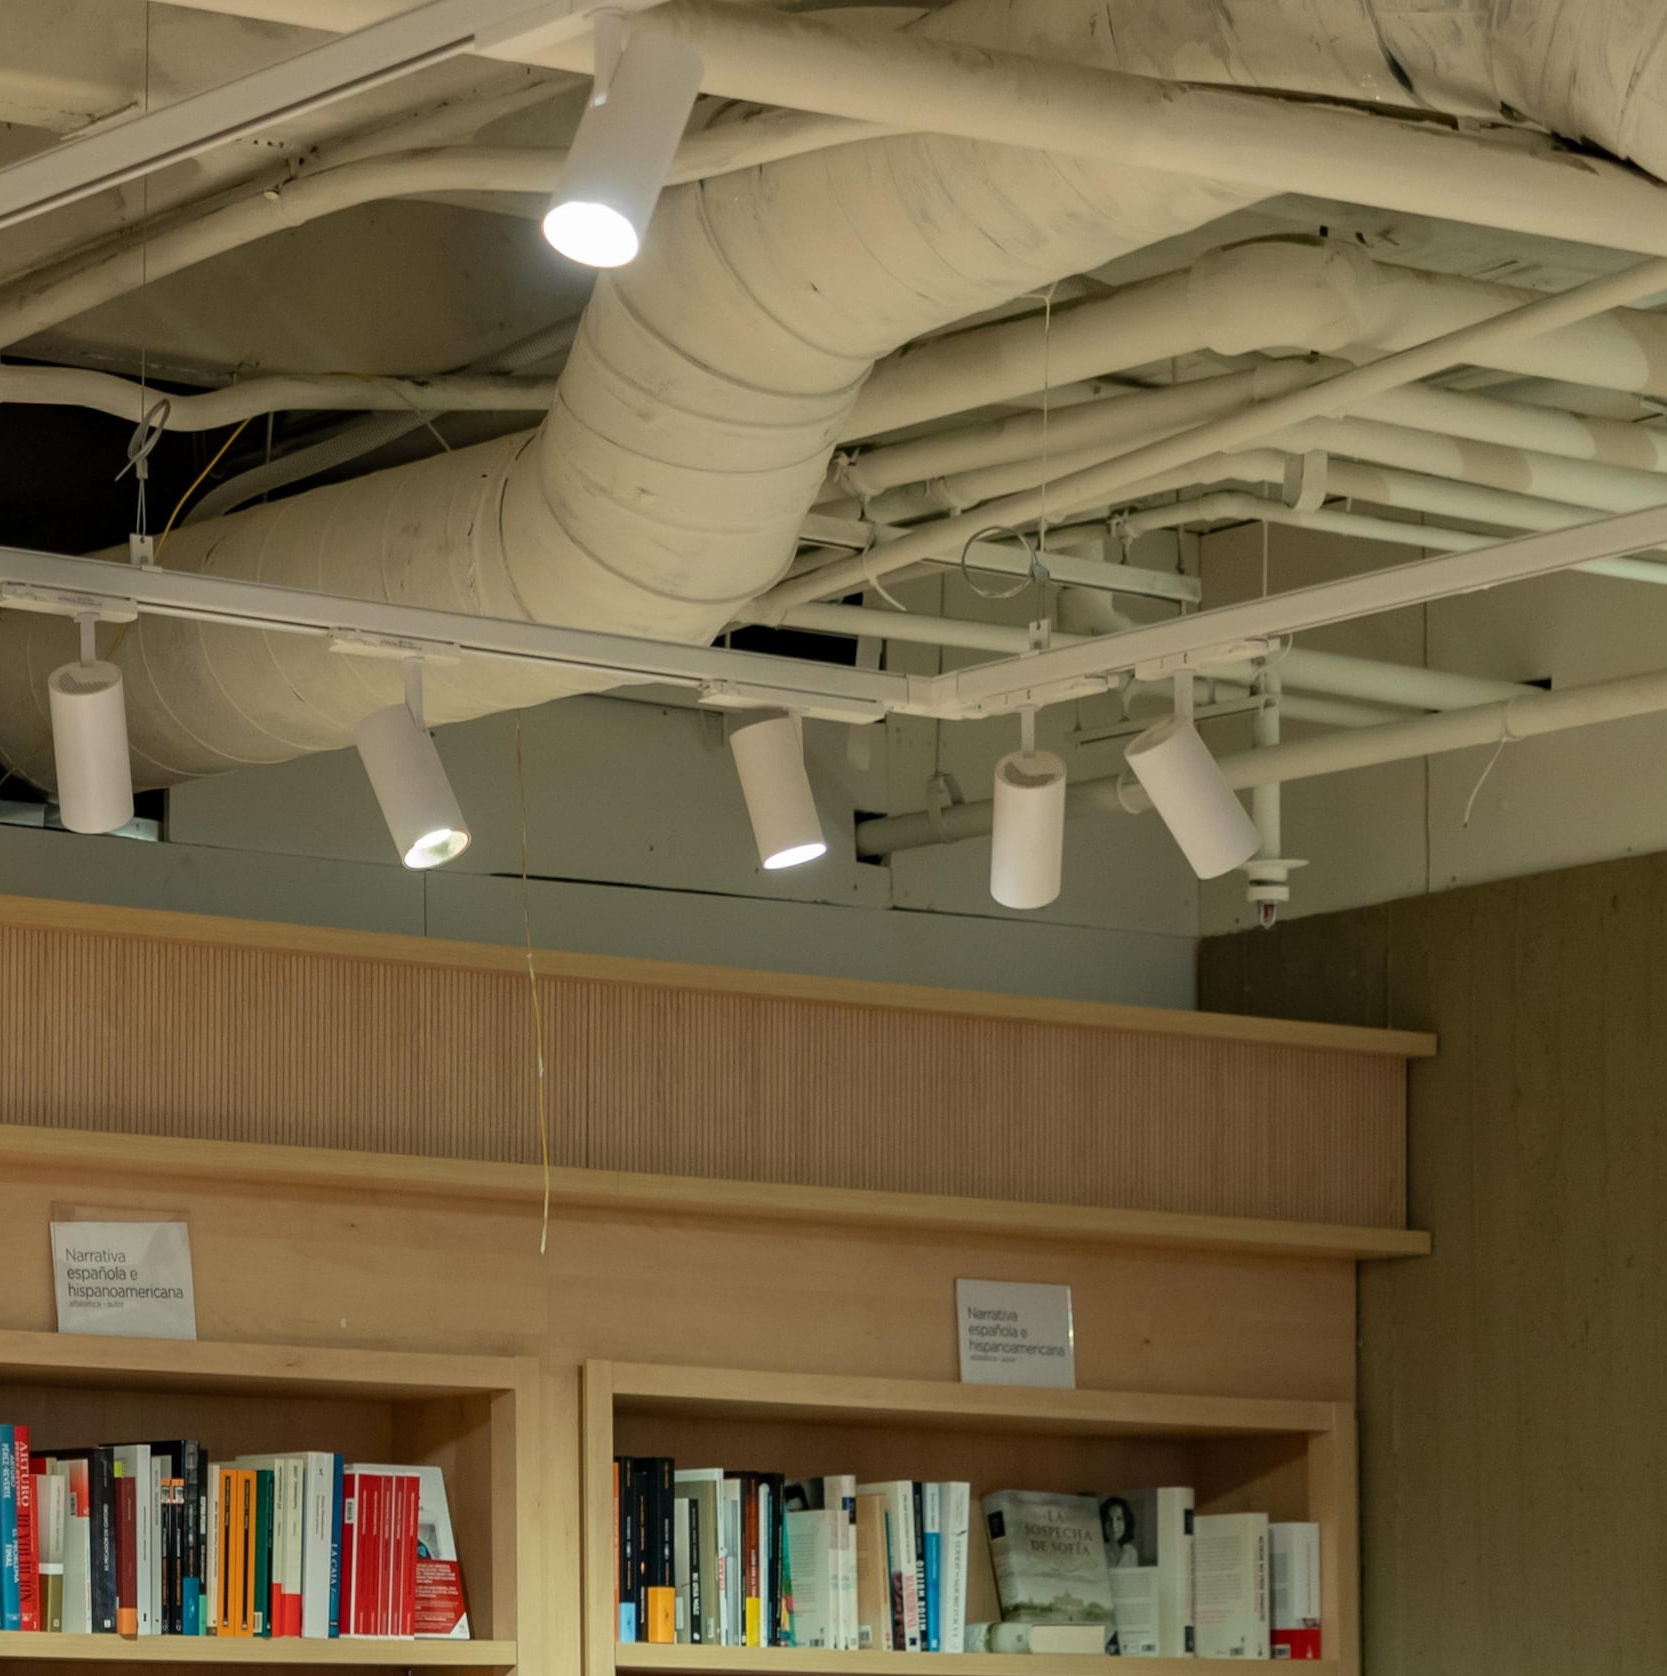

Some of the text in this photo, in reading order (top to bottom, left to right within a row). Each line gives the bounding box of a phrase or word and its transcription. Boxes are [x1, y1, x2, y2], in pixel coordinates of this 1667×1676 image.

[66, 1248, 126, 1263] Narrativa
[67, 1266, 138, 1282] española e
[68, 1283, 184, 1300] hispanoamericana
[968, 1306, 1018, 1322] Narrativa
[968, 1324, 1018, 1338] española
[19, 1441, 30, 1507] ARTURO
